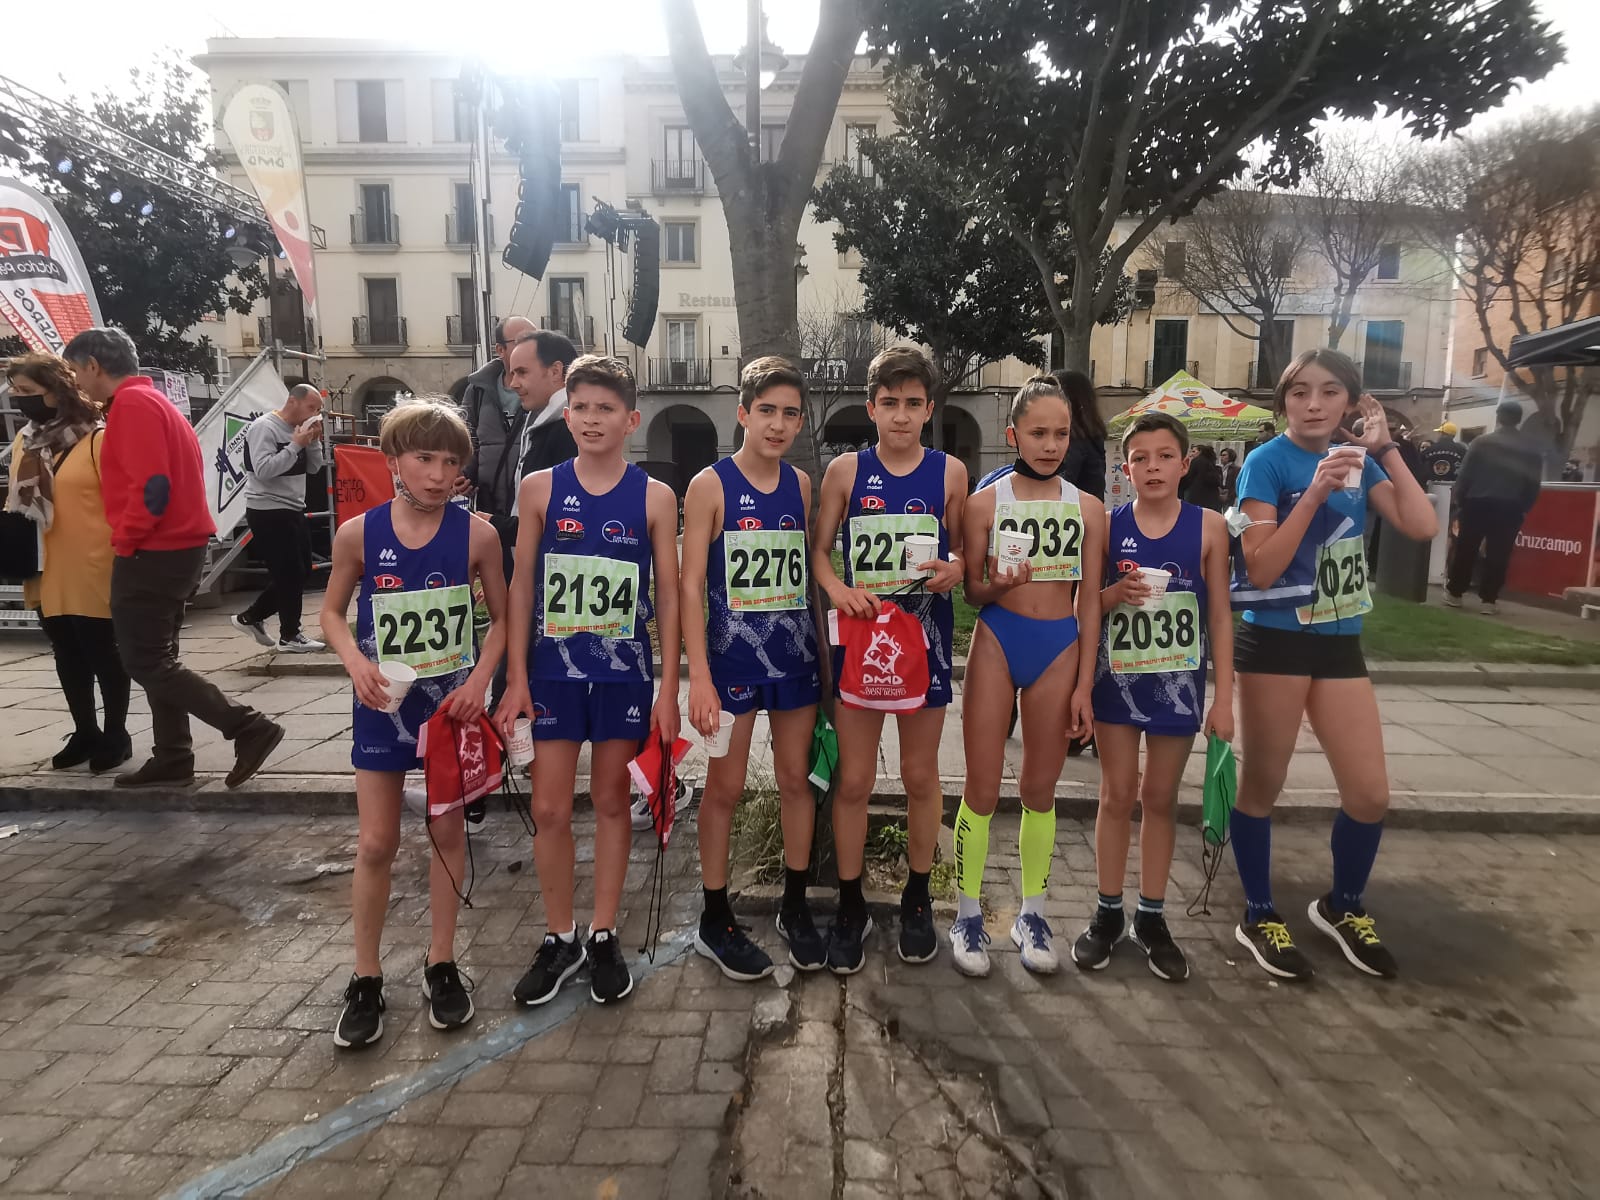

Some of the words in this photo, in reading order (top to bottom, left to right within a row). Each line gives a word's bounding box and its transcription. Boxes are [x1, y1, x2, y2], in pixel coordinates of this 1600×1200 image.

[679, 292, 737, 308] Restaur
[855, 532, 935, 571] 227
[1515, 530, 1582, 556] Cruzcampo
[730, 548, 802, 588] 2276
[1319, 552, 1365, 597] 025
[548, 572, 632, 617] 2134
[379, 604, 468, 655] 2237
[1112, 608, 1195, 651] 2038
[863, 673, 904, 685] DMD
